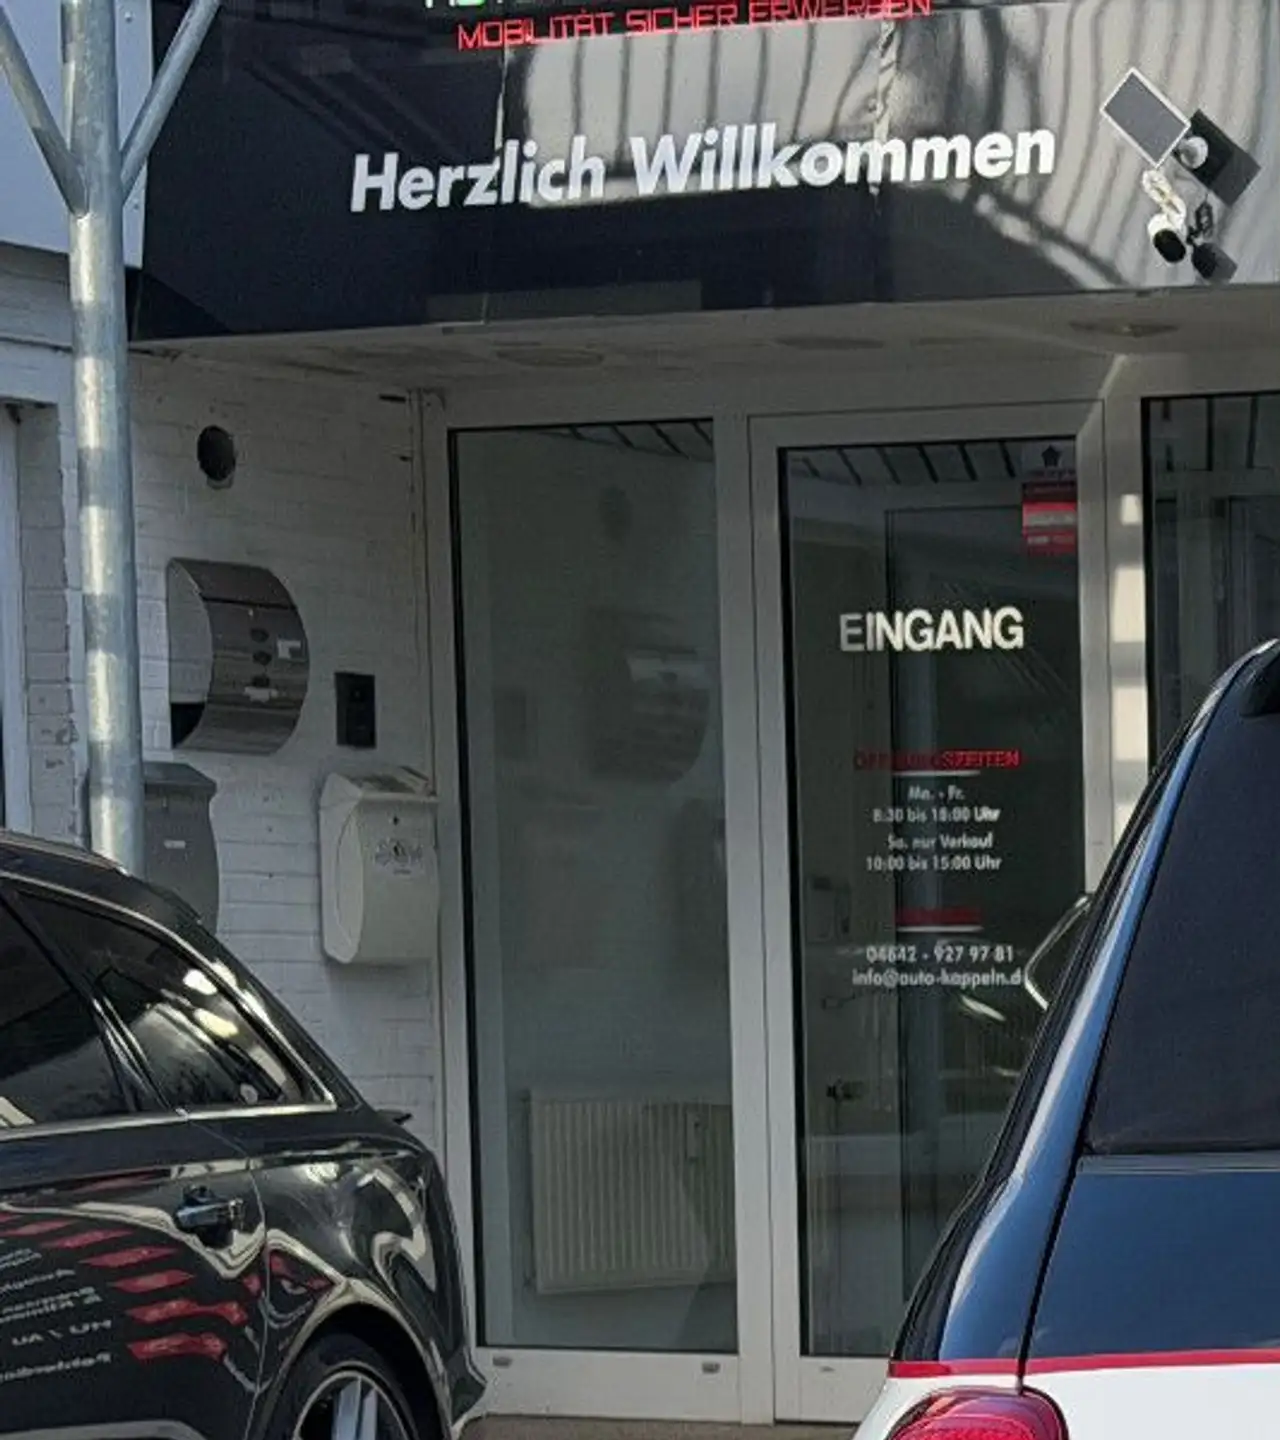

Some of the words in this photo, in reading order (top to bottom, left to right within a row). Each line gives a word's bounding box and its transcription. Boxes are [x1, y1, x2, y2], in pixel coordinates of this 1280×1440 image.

[458, 9, 614, 50] MOBILITÄT
[625, 4, 738, 37] SICHER
[749, 0, 932, 26] ERWERBEN
[350, 135, 606, 212] Herzlich
[631, 123, 1056, 195] Willkommen
[839, 605, 1024, 651] EINGANG
[906, 806, 927, 823] bis
[974, 805, 1001, 823] Uhr
[912, 837, 936, 849] nur
[939, 832, 993, 849] Verkauf
[907, 854, 928, 871] bis
[974, 854, 1003, 870] Uhr
[934, 944, 963, 962] 927
[969, 945, 991, 962] 97
[852, 967, 1024, 989] info@auto-kappeln.d
